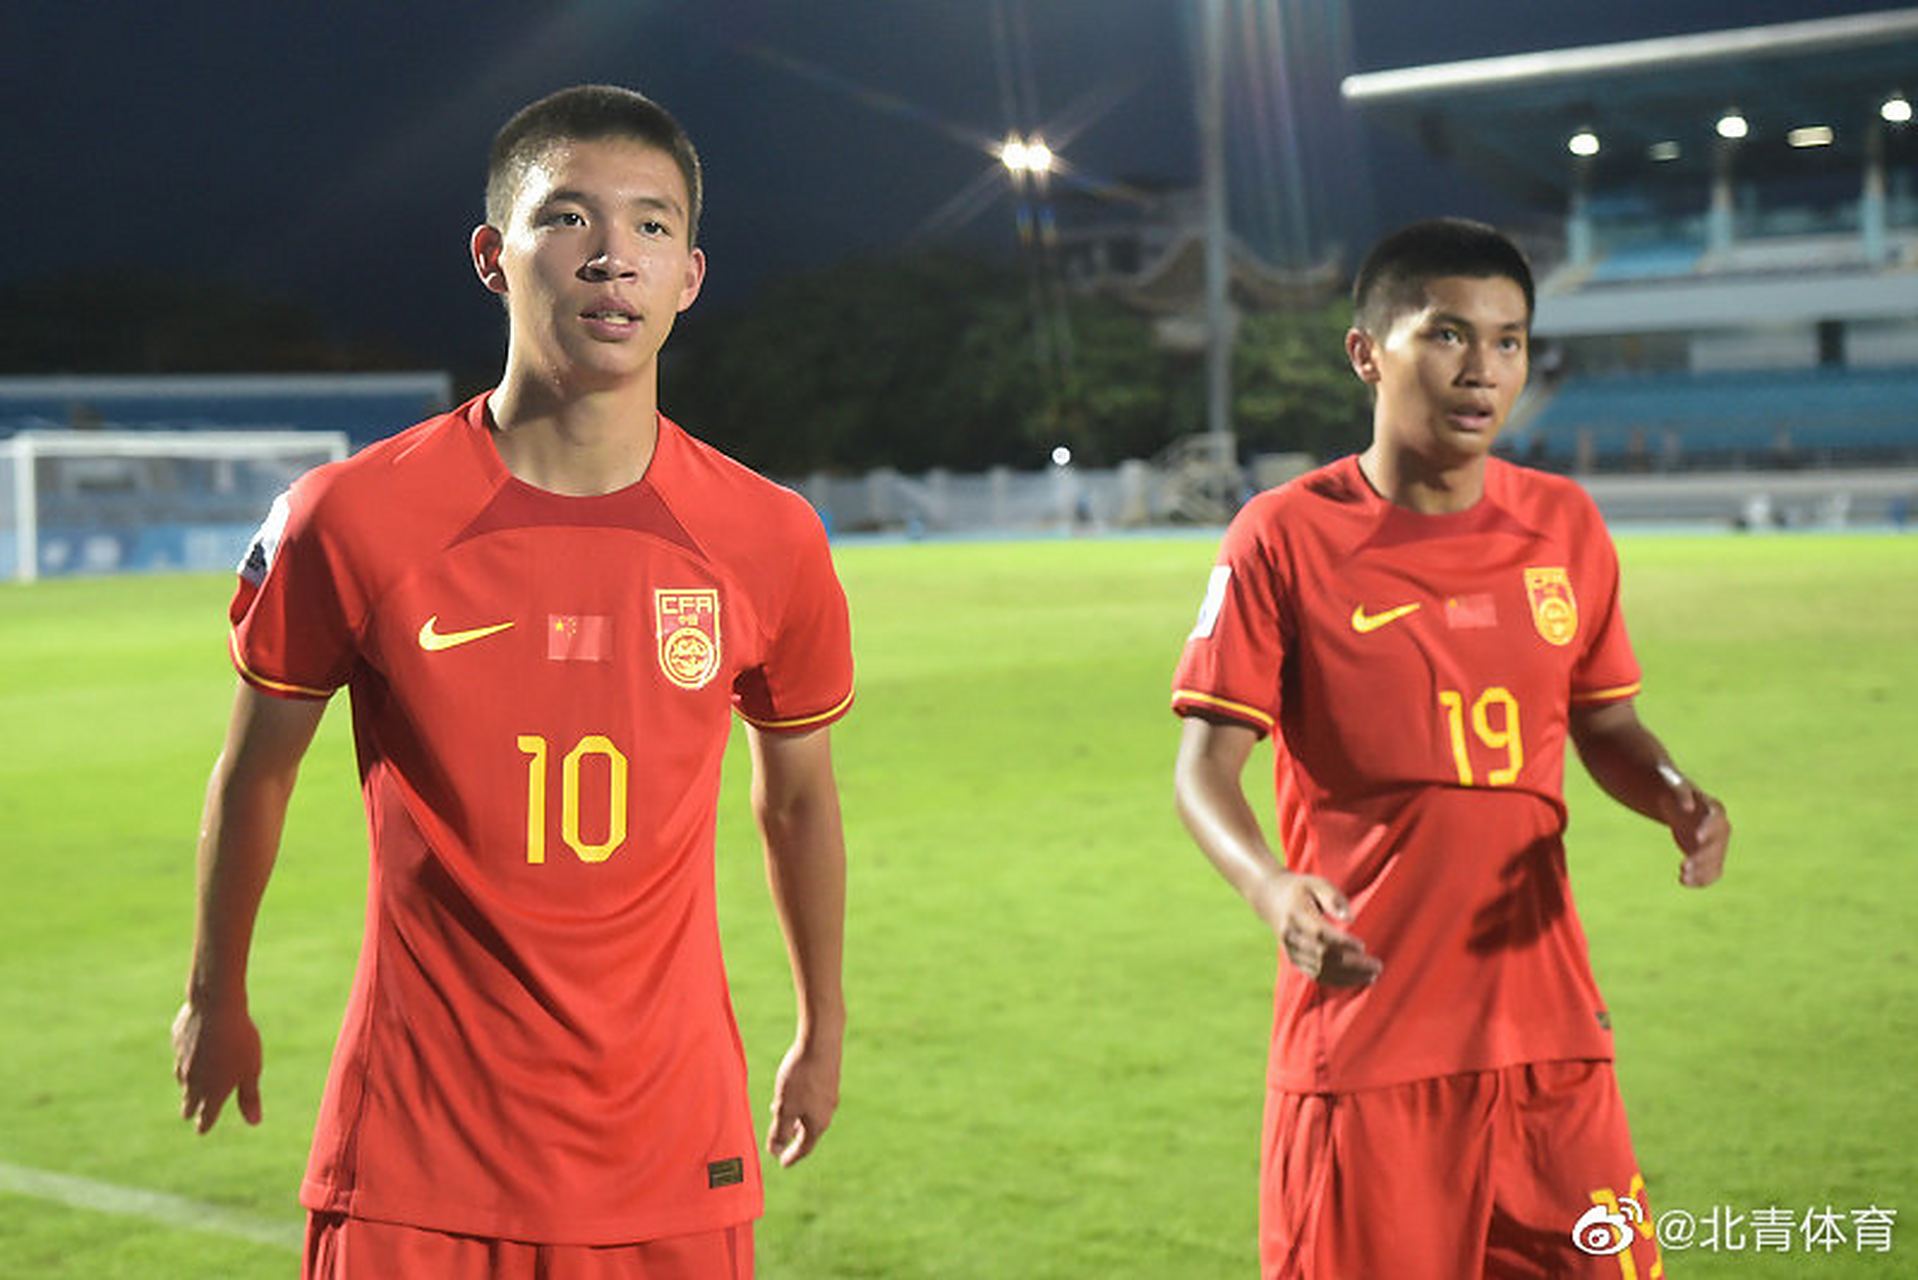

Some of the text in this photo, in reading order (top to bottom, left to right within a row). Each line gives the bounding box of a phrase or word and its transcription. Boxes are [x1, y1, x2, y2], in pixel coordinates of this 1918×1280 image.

[661, 597, 712, 614] CFA
[1440, 687, 1523, 786] 19
[517, 735, 627, 864] 10
